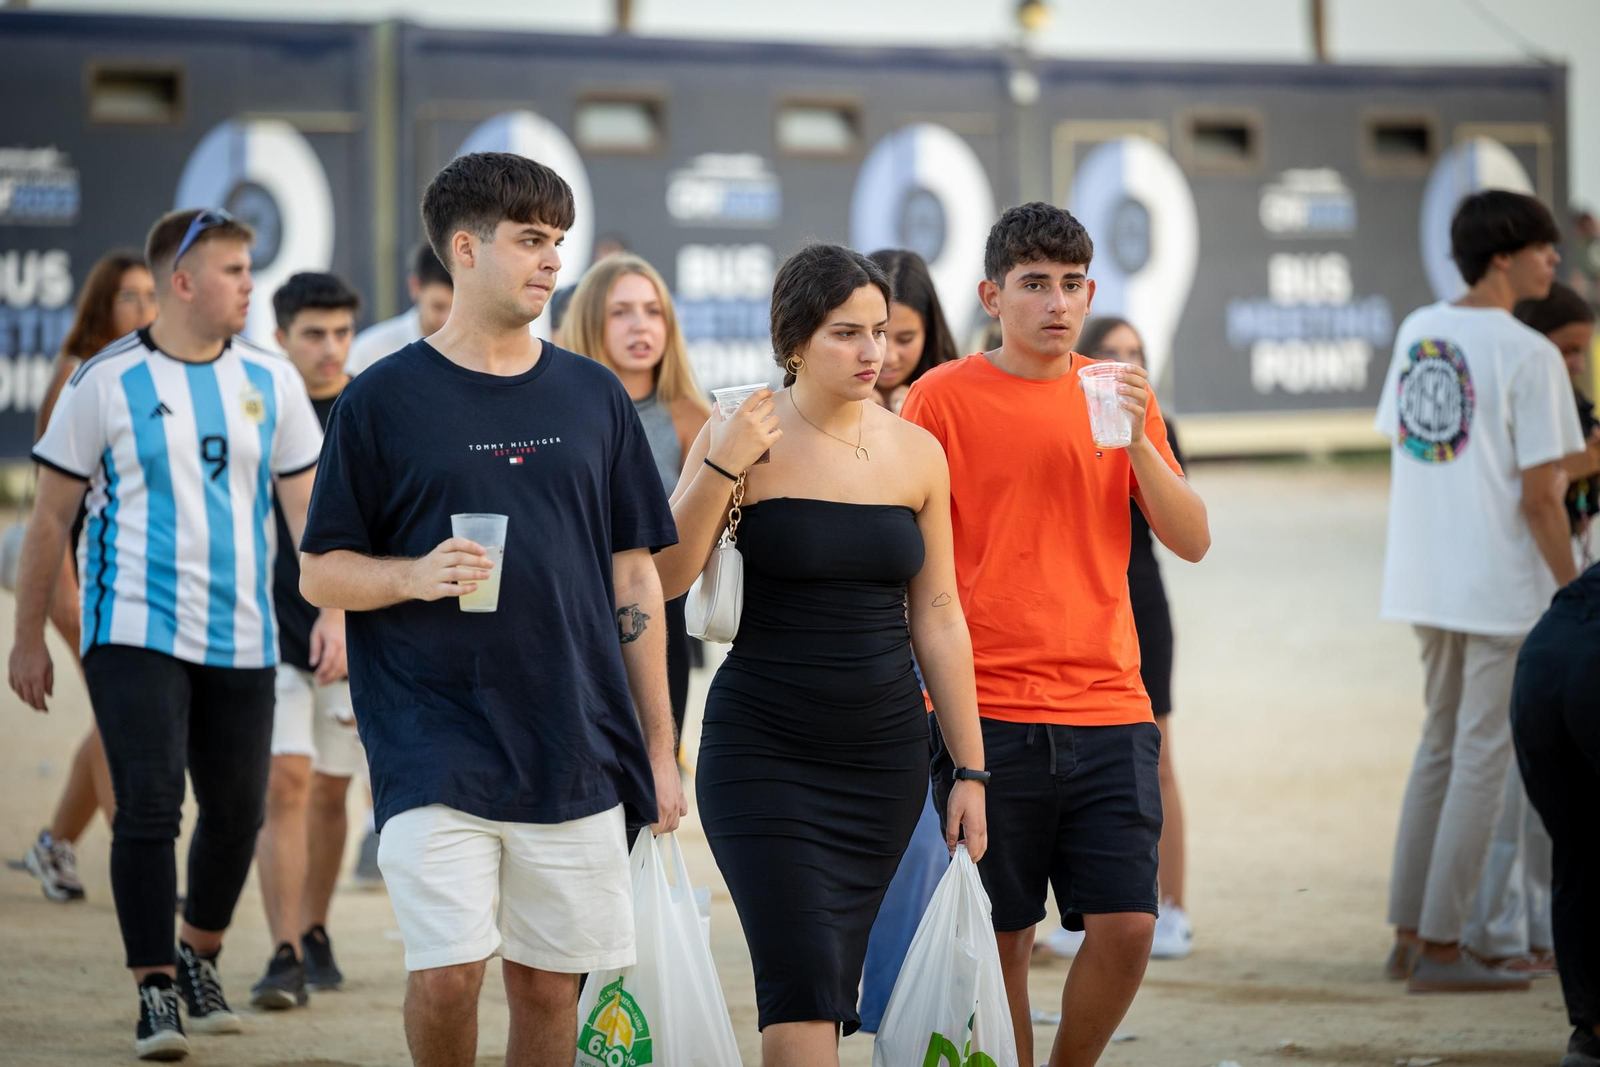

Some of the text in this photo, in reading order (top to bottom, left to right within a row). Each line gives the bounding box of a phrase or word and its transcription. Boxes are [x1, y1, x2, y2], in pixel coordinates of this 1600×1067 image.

[0, 250, 73, 308] US
[677, 244, 775, 299] BUS
[1268, 252, 1353, 307] BUS
[1226, 297, 1394, 348] MEETING
[1251, 338, 1372, 395] POINT
[202, 435, 228, 481] 9
[468, 436, 562, 451] TOMMY HILFIGER
